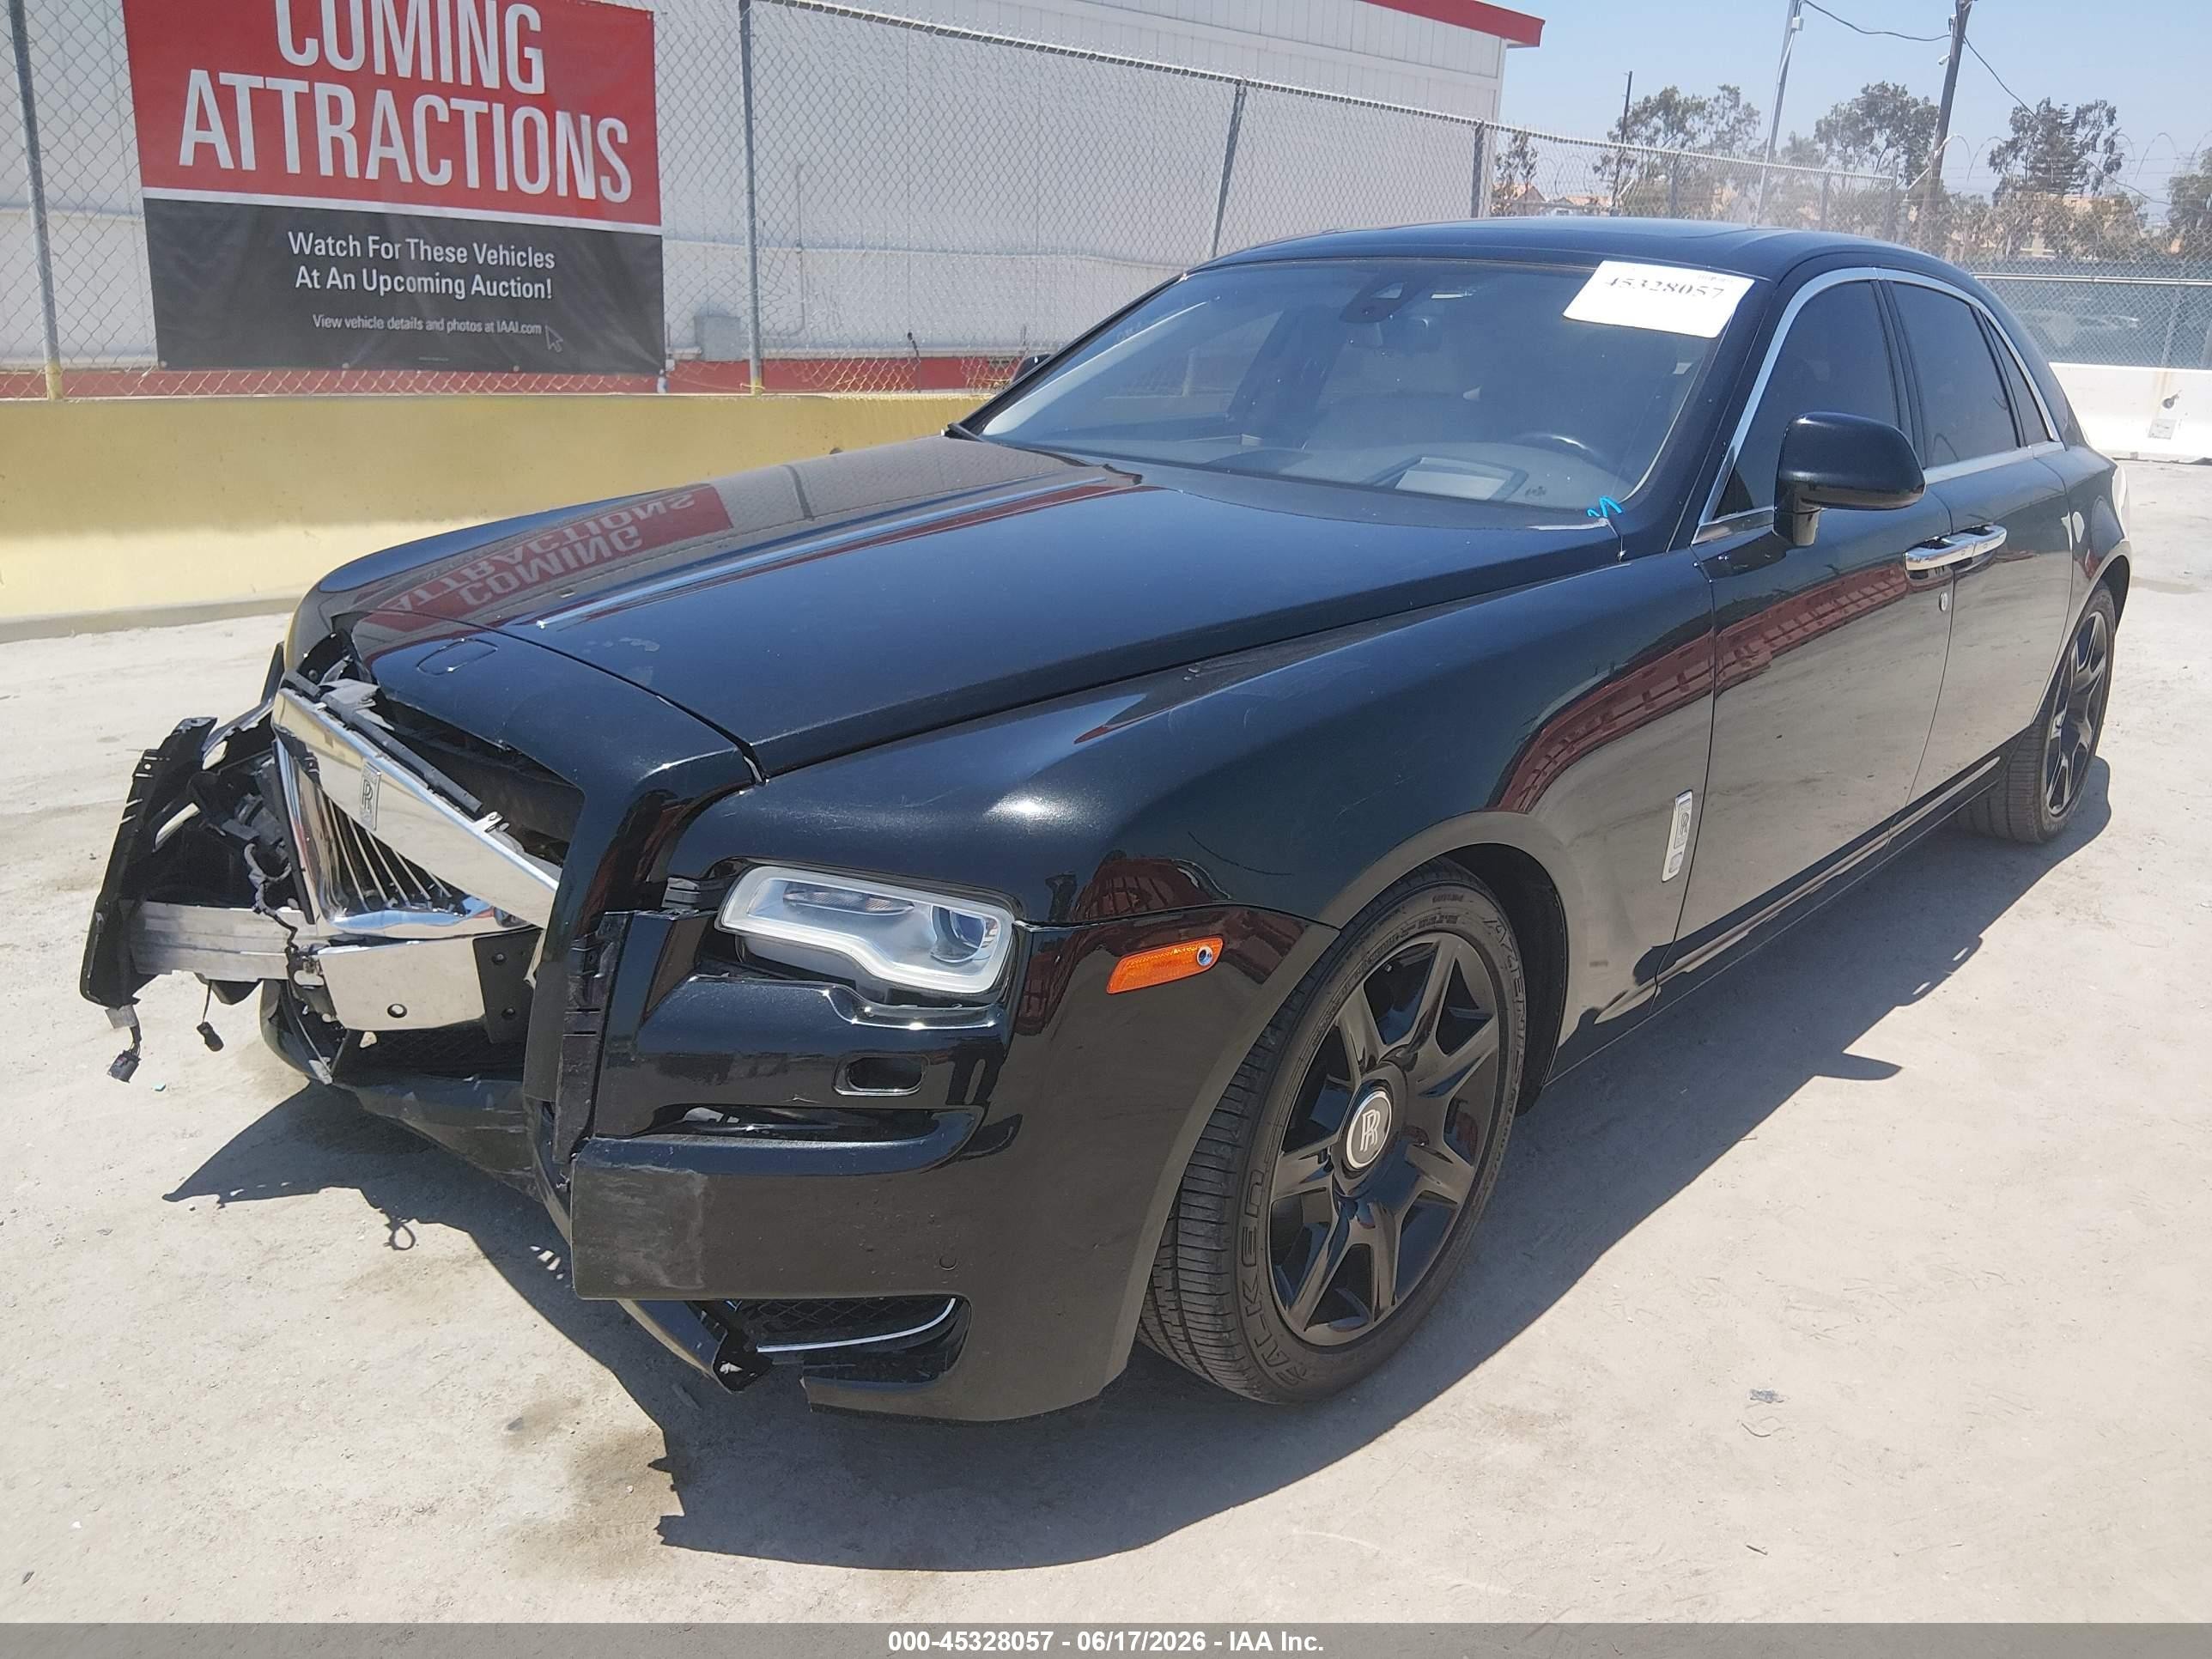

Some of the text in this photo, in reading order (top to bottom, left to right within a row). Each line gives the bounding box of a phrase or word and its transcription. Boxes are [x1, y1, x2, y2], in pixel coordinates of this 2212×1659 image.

[275, 0, 545, 94] COMING
[179, 69, 632, 204] ATTRACTIONS
[289, 231, 556, 269] Watch For These Vehicles
[295, 265, 552, 300] At An Upcoming Auction!
[1605, 276, 1725, 299] 45328057
[313, 314, 542, 334] View vehicle details and photos at IAAI.com
